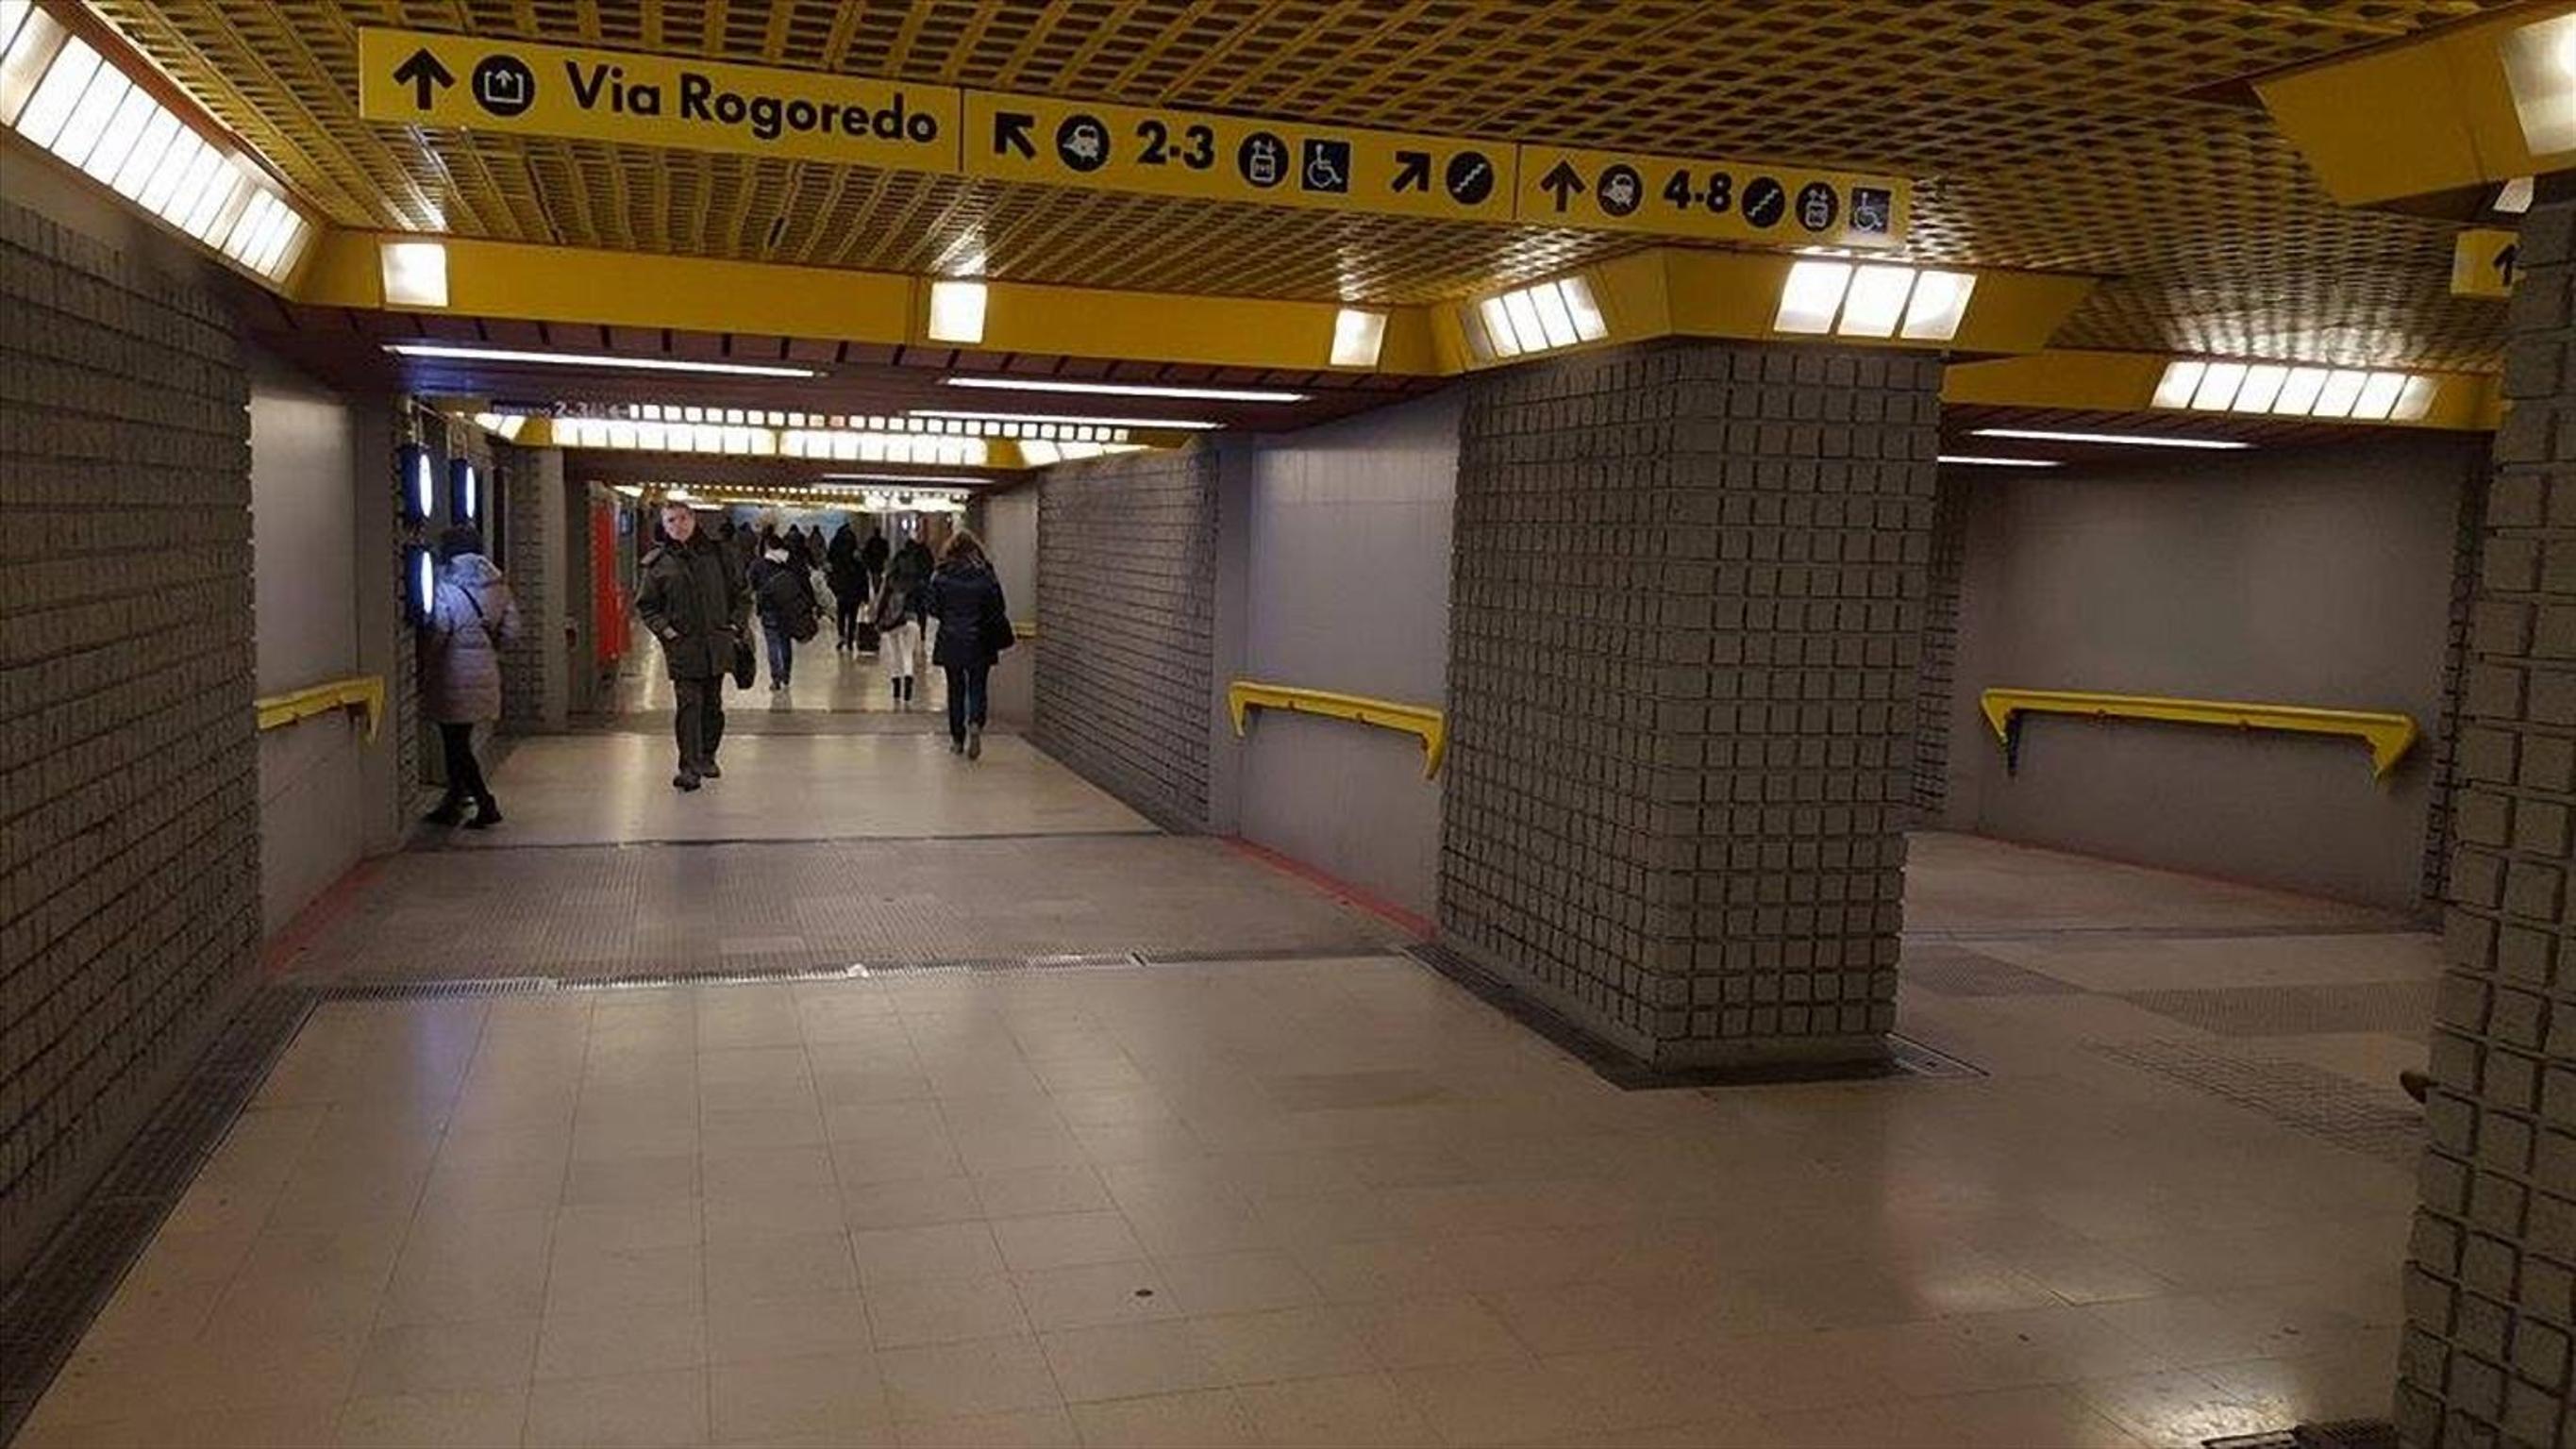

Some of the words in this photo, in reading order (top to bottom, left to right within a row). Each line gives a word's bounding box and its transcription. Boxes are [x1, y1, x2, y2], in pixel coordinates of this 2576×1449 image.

[565, 60, 660, 115] Via
[680, 73, 937, 142] Rogoredo
[1137, 120, 1214, 170] 2-3
[1664, 169, 1732, 213] 4-8
